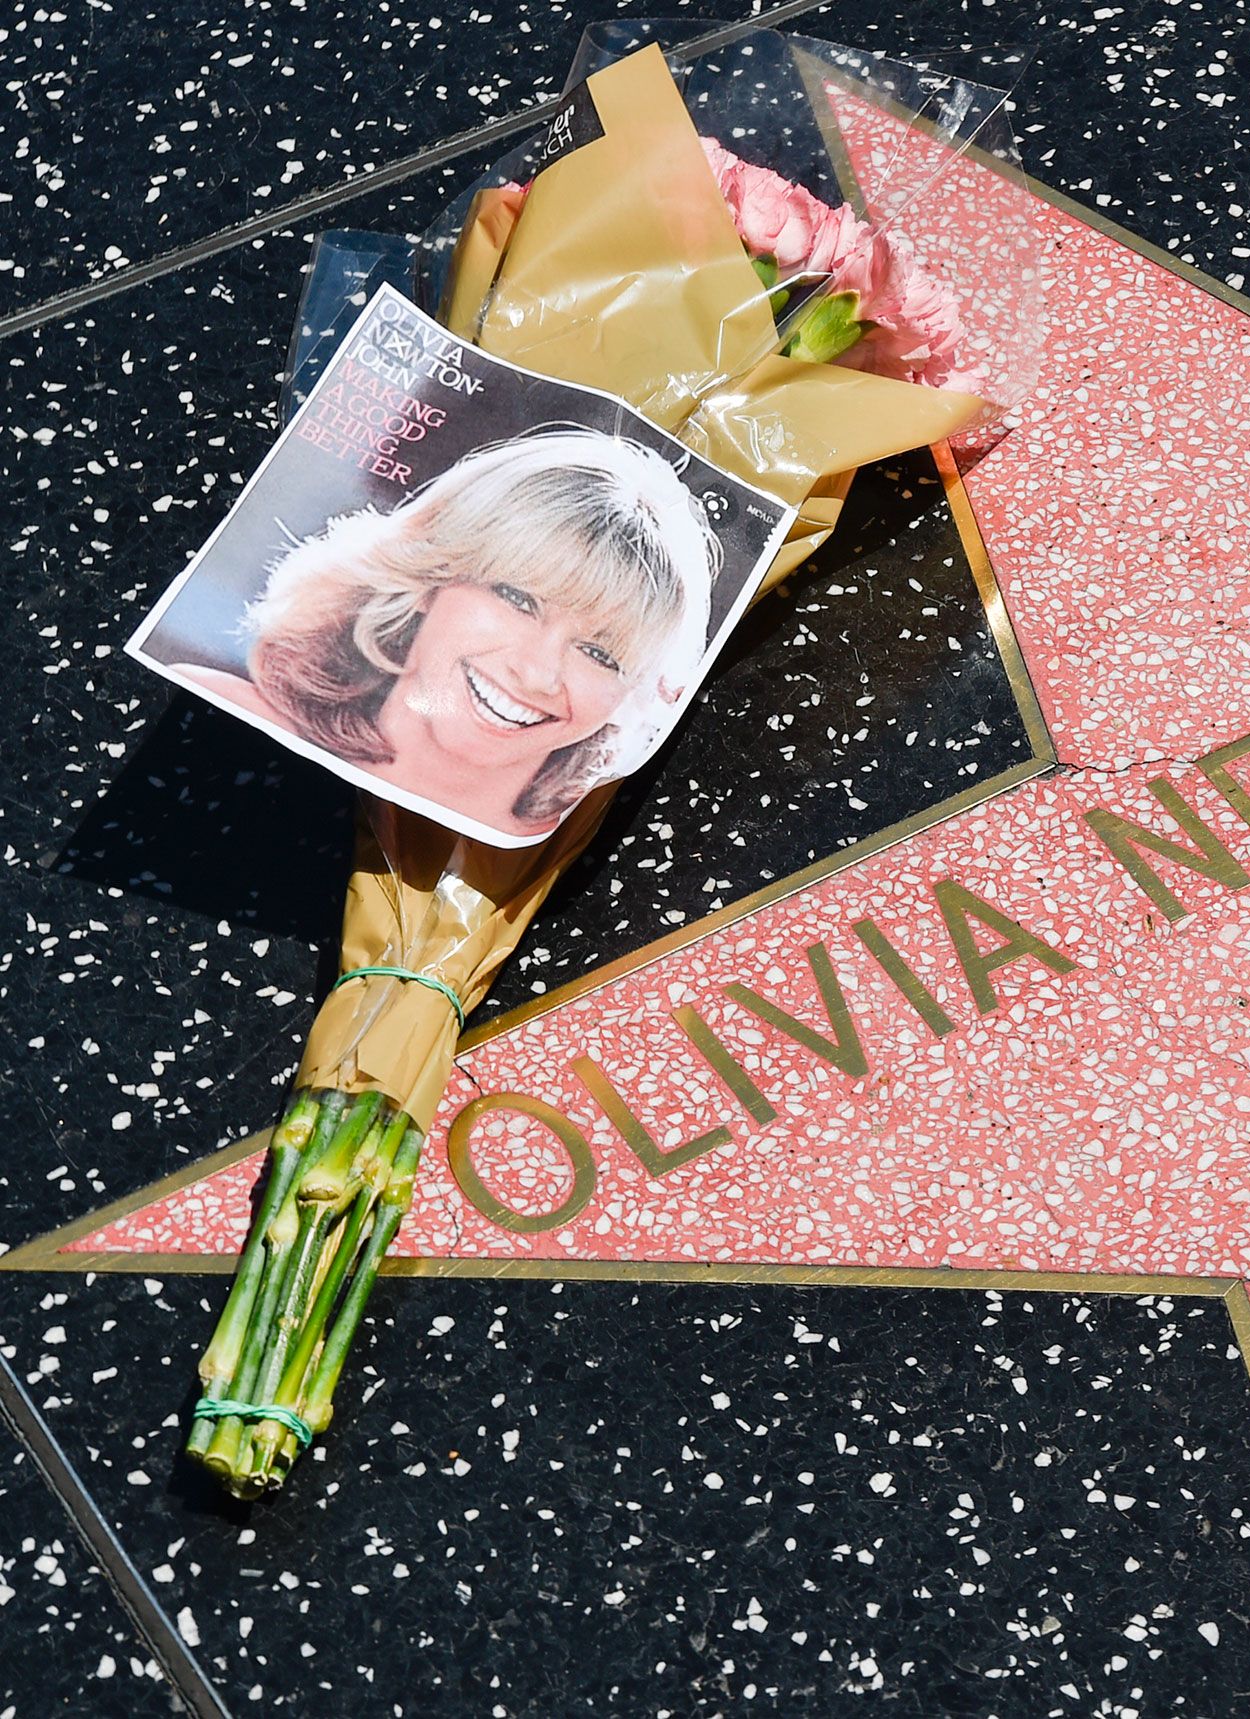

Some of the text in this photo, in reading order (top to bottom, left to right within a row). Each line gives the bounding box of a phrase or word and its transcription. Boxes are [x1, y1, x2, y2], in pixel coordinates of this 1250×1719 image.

[344, 341, 419, 391] JOHN
[362, 317, 485, 396] NWTON-
[379, 299, 464, 369] OLIVIA
[316, 398, 400, 456] THING
[325, 383, 427, 442] A GOOD
[338, 358, 447, 428] MAKING
[297, 418, 412, 485] BETTER
[446, 878, 1080, 1234] OLIVIA
